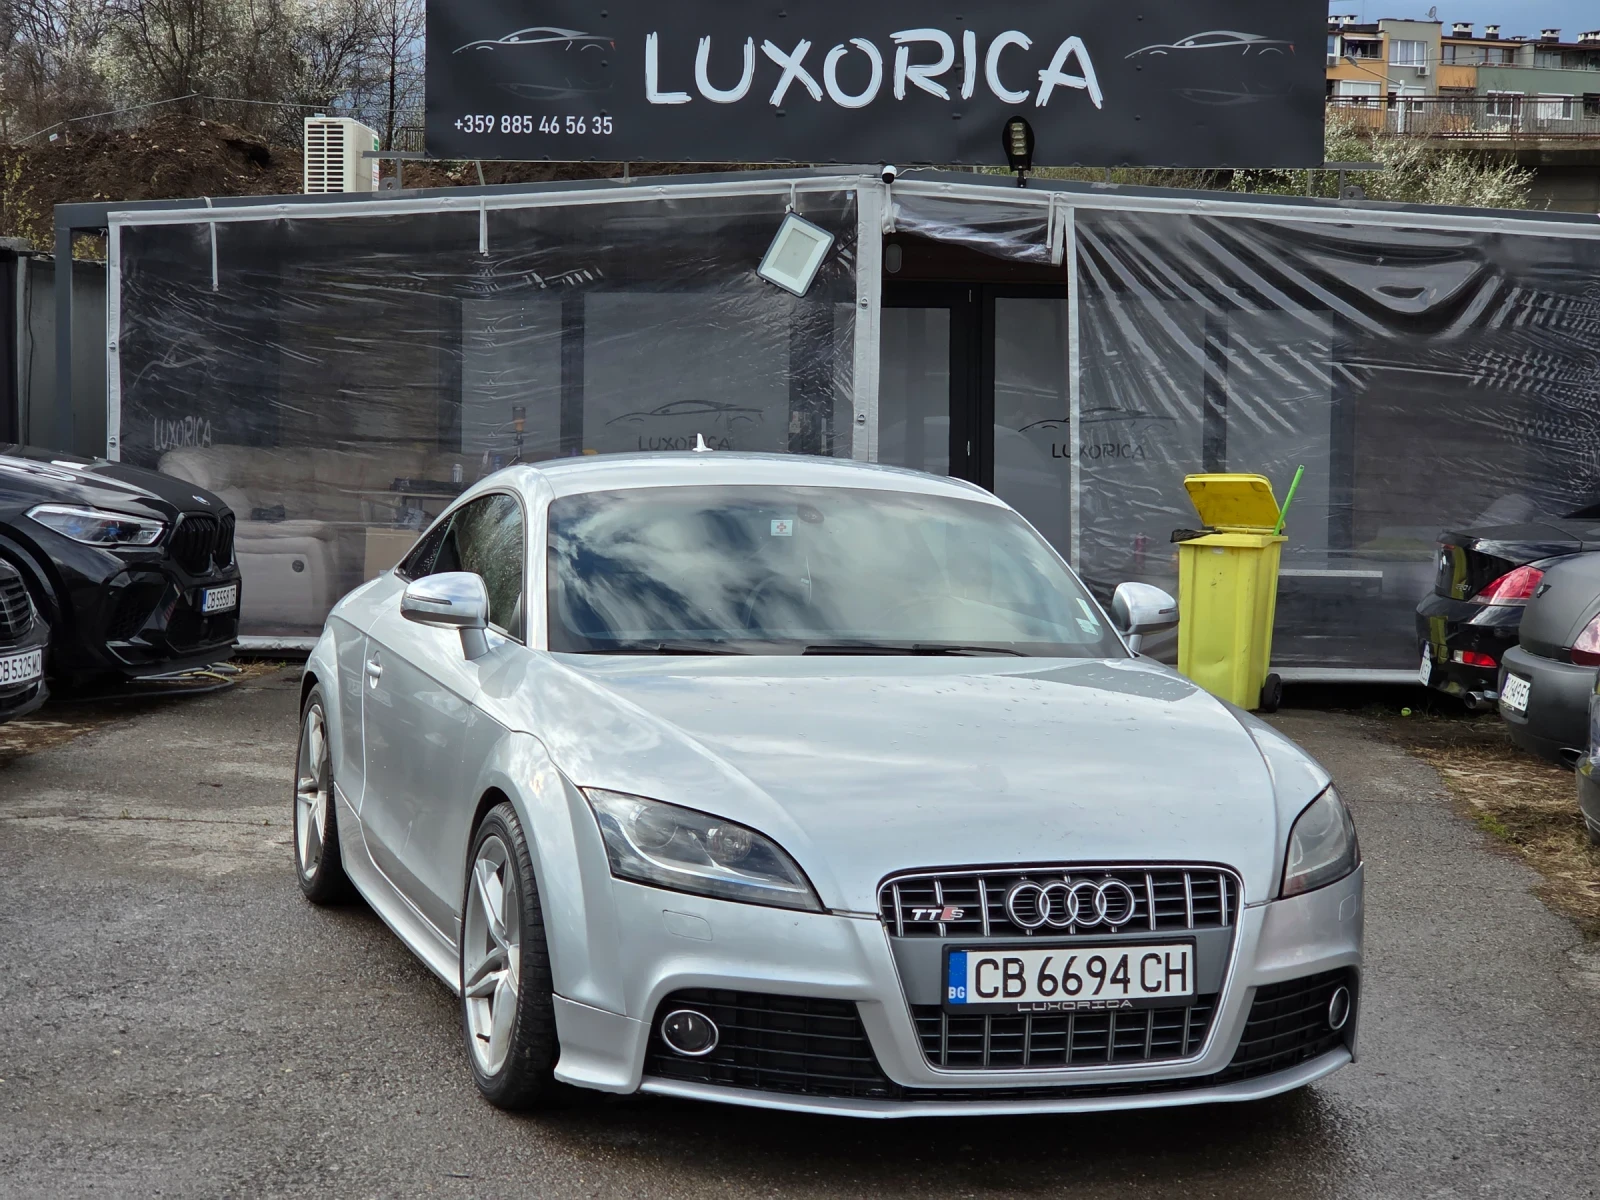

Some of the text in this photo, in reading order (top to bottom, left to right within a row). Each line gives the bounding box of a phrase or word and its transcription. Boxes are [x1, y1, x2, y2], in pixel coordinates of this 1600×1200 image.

[645, 28, 1103, 109] LUXORICA
[454, 115, 613, 135] +359 885 46 56 35
[153, 416, 211, 451] LUXORICA
[911, 908, 965, 921] TTS
[974, 951, 1187, 998] CB 6694 CH
[948, 986, 966, 999] BG
[1017, 1000, 1134, 1012] LUXORICA
